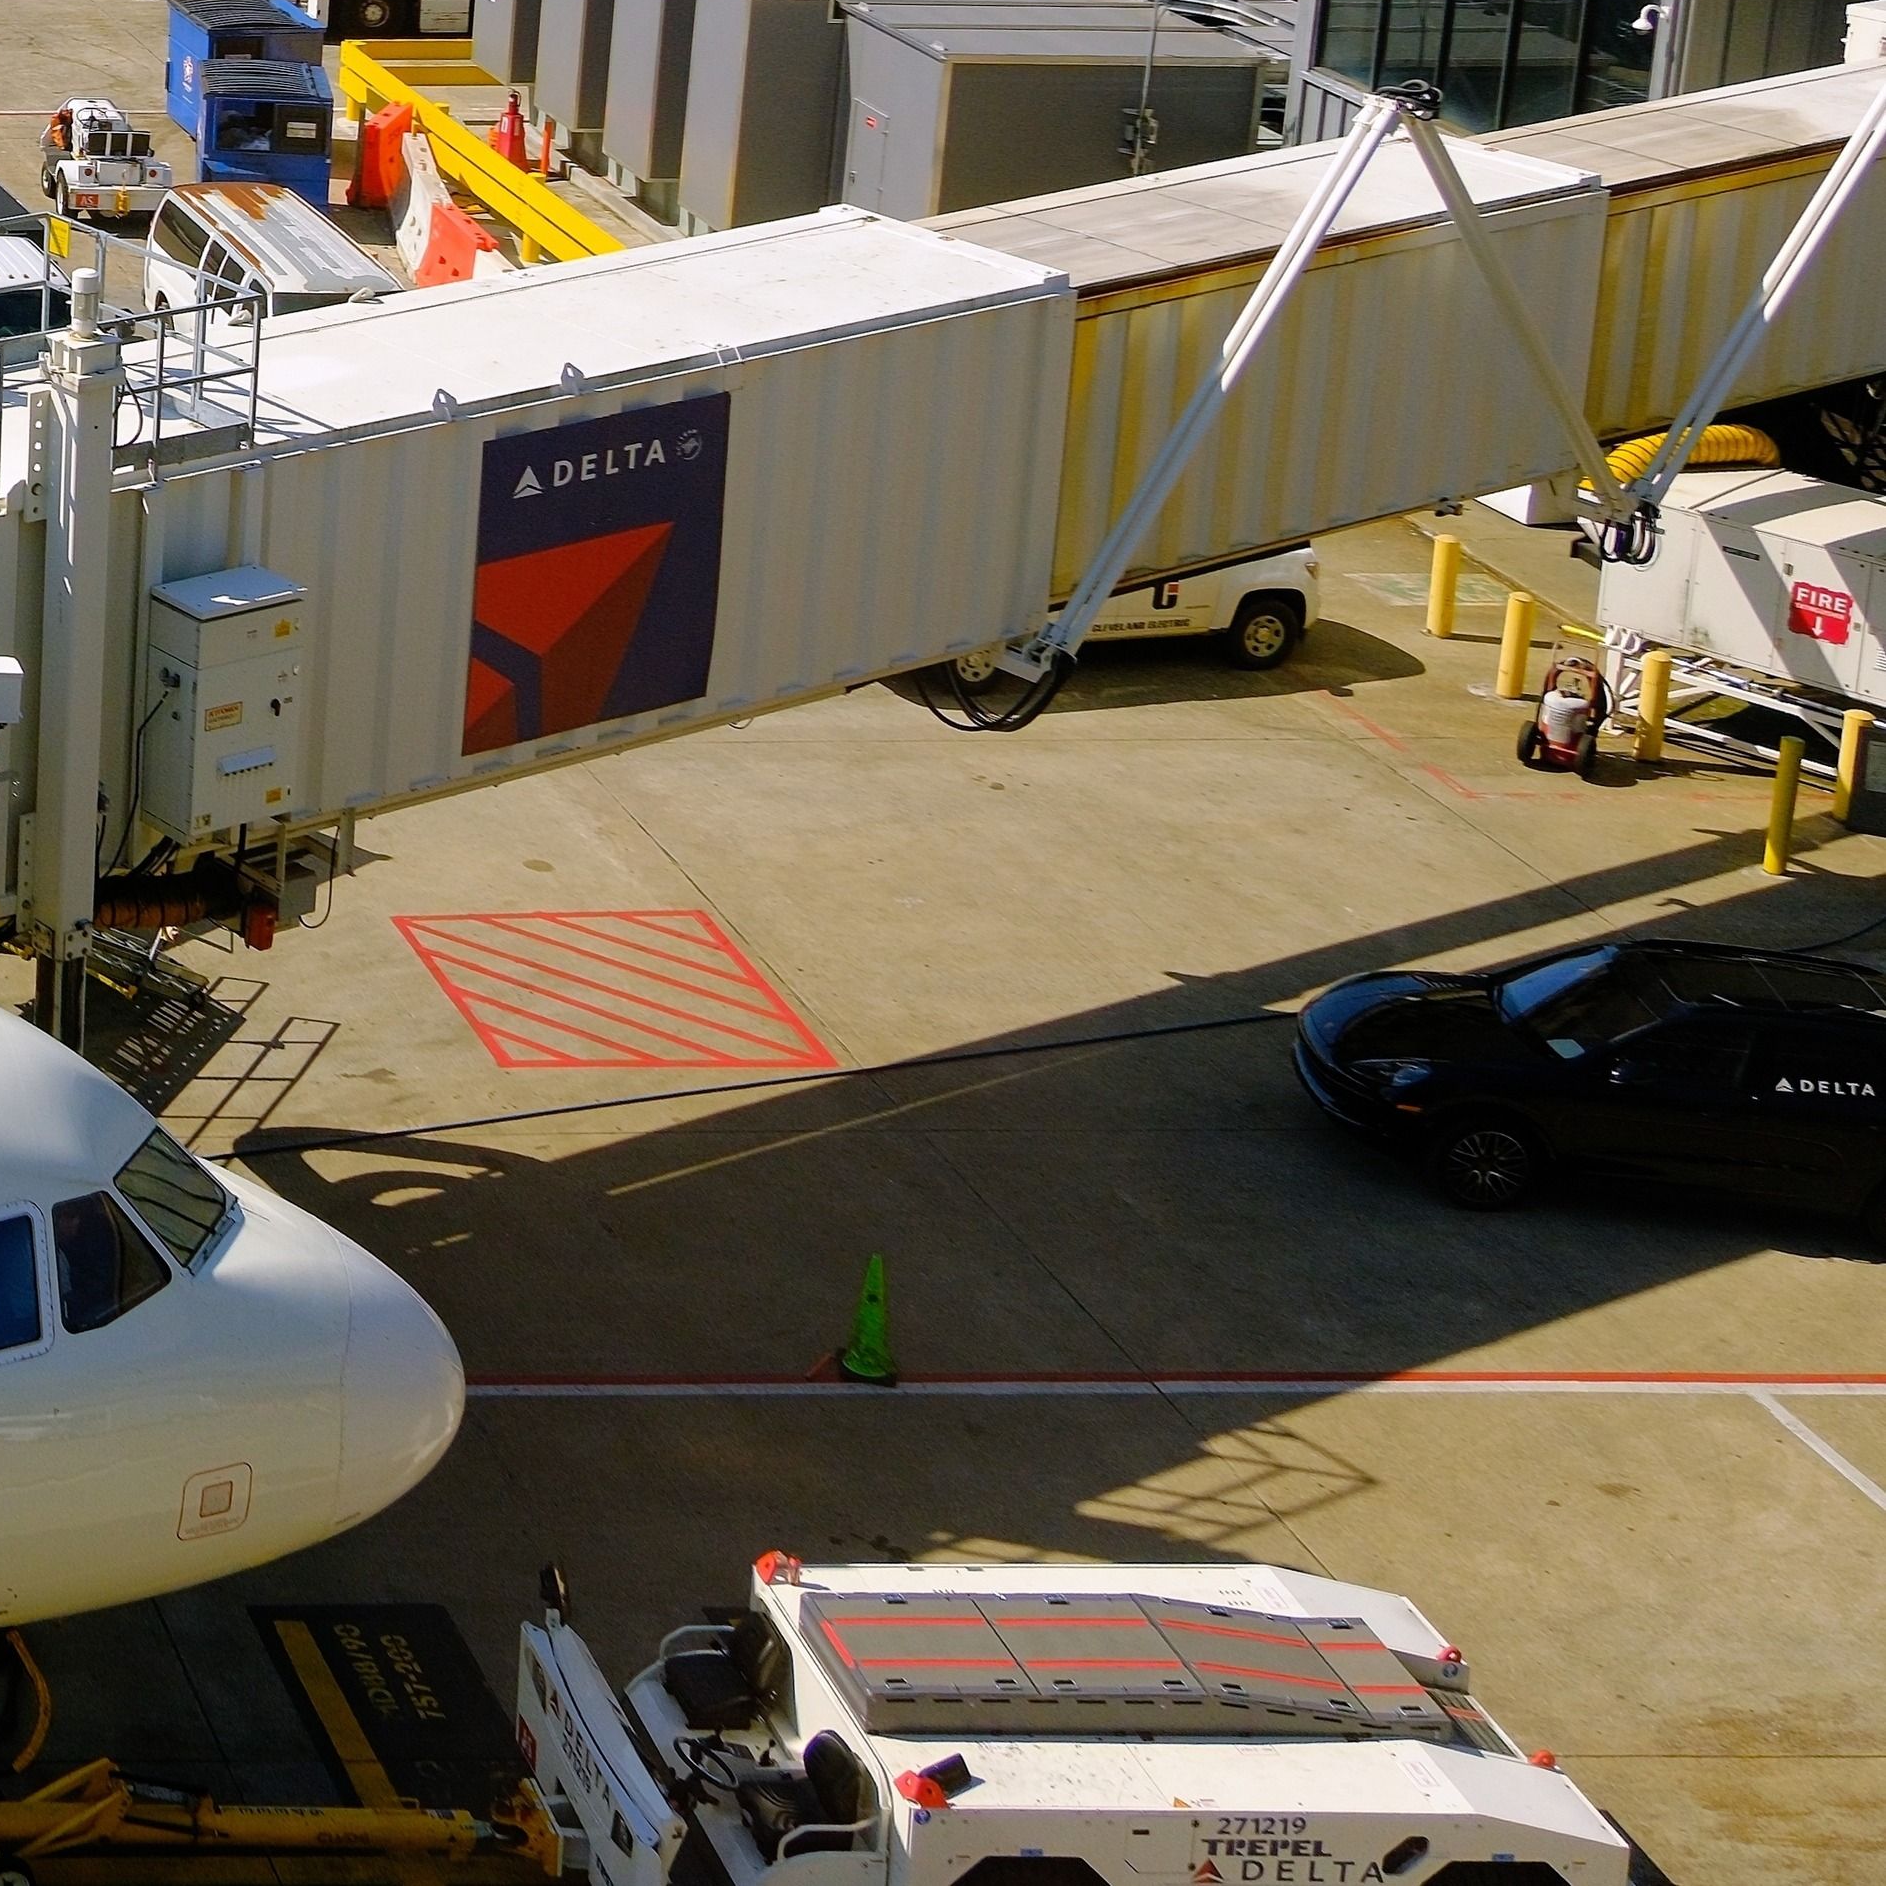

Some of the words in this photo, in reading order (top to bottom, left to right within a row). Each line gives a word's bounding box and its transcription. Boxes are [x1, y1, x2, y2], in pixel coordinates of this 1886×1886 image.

[553, 439, 667, 488] DELTA
[1795, 585, 1848, 614] FIRE
[1091, 621, 1144, 633] CLEVELAND
[1147, 618, 1191, 630] ELECTRIC
[1799, 1079, 1877, 1097] DELTA
[564, 1712, 611, 1804] DELTA
[1217, 1817, 1307, 1836] 271219
[1202, 1838, 1332, 1857] TREPEL
[1241, 1860, 1385, 1885] DELTA
